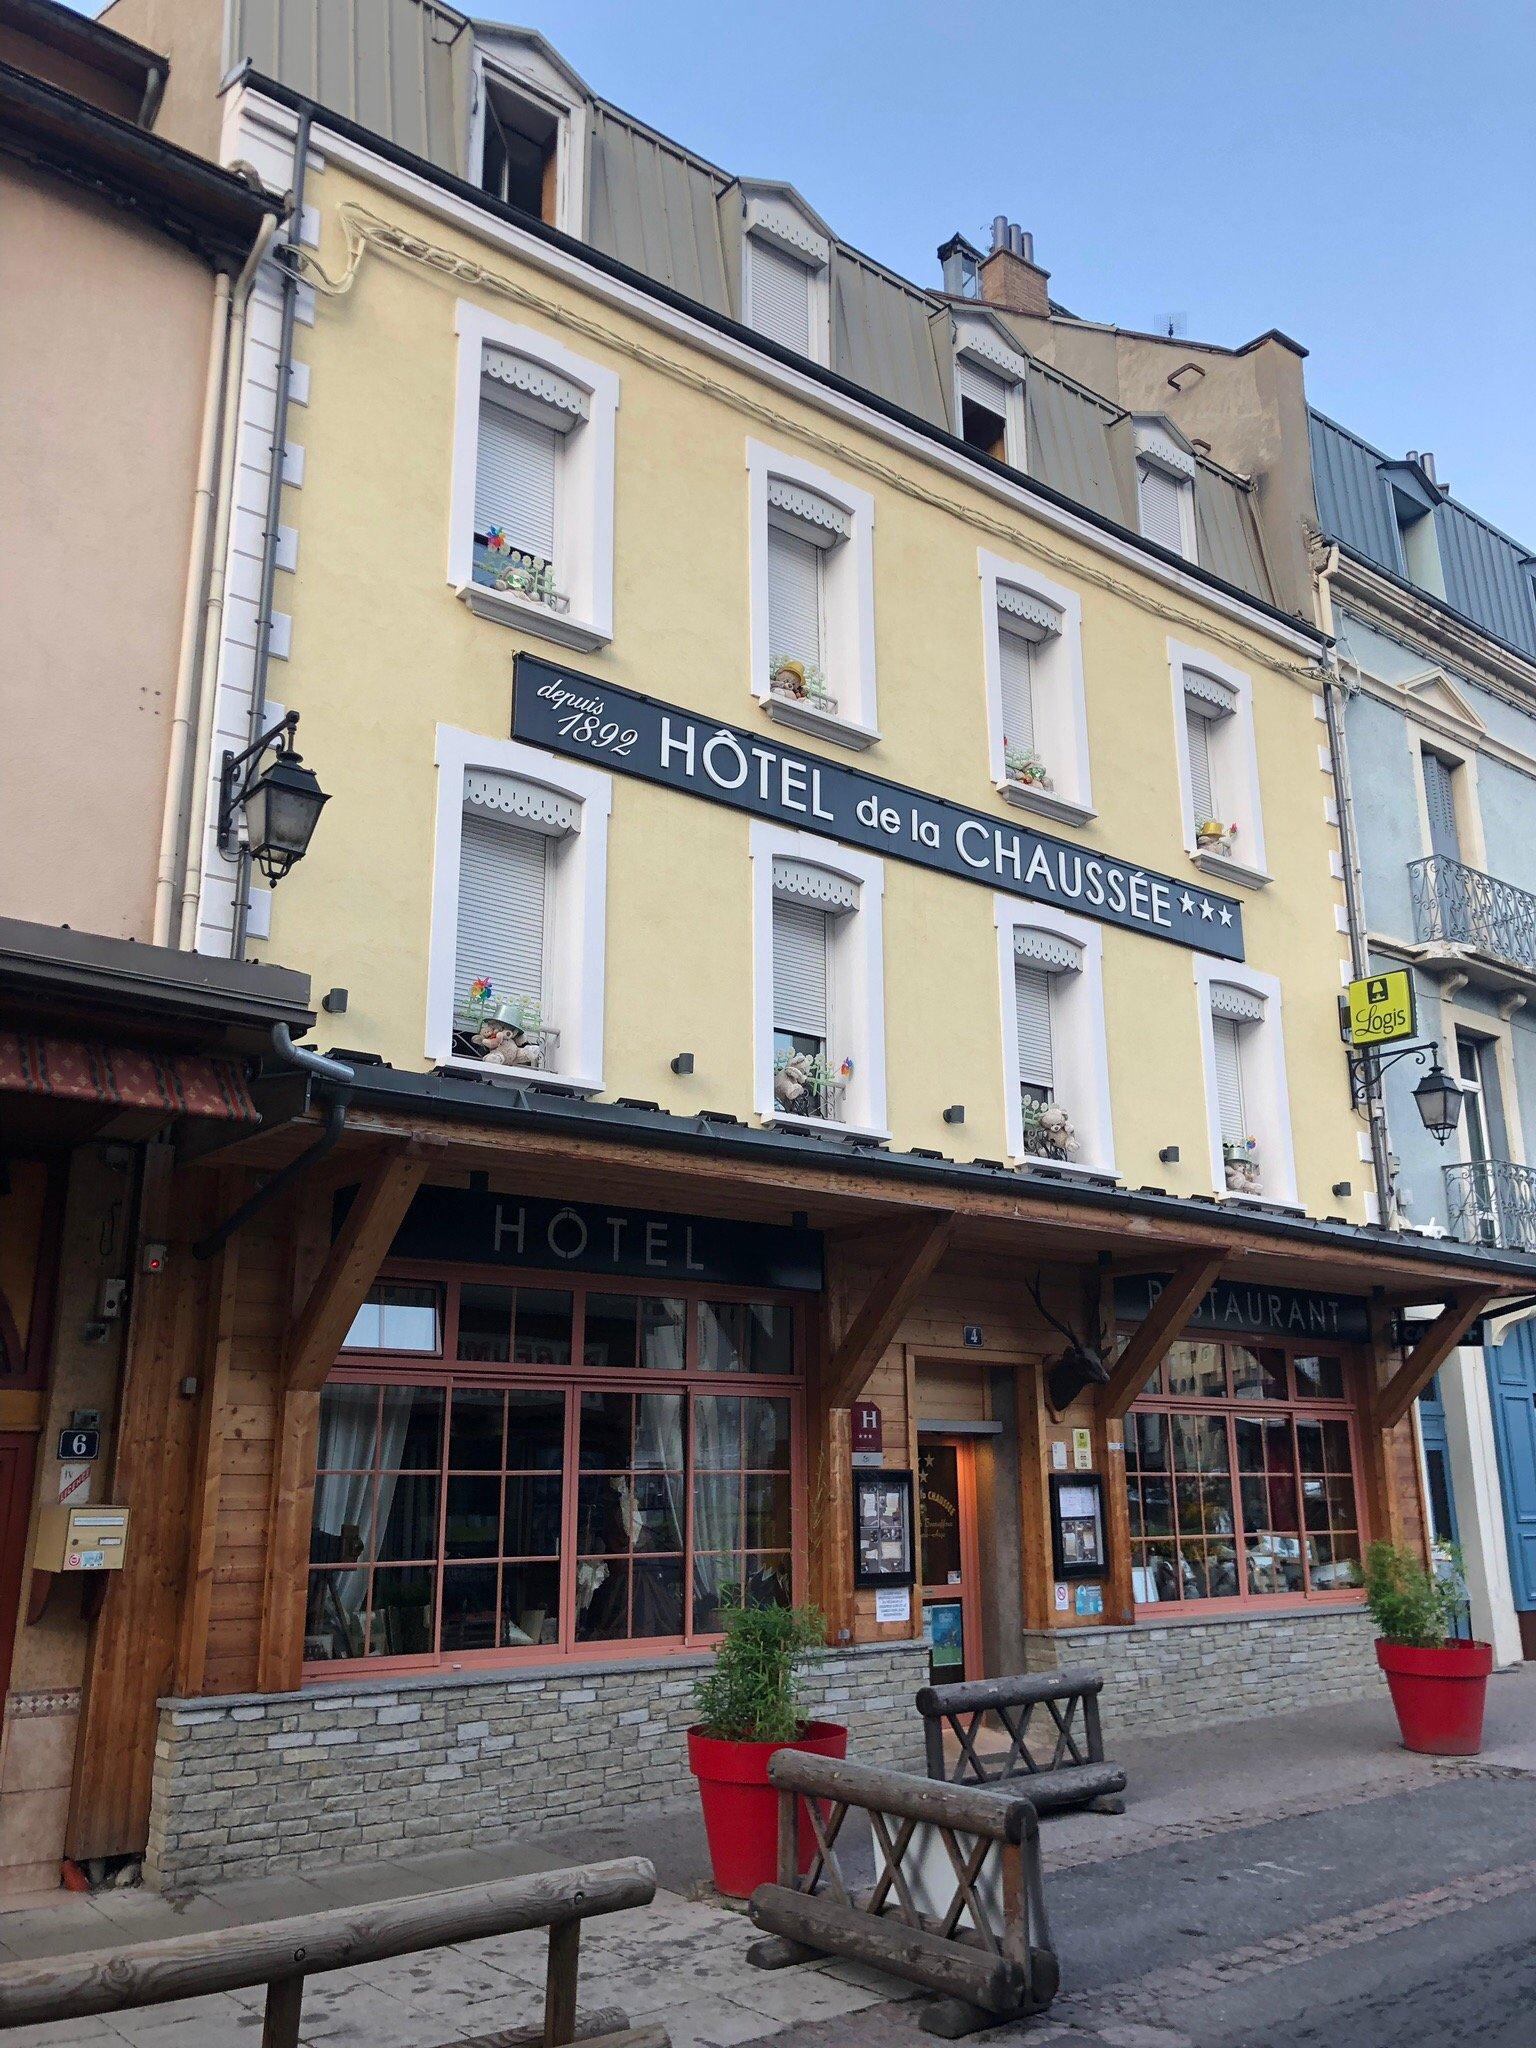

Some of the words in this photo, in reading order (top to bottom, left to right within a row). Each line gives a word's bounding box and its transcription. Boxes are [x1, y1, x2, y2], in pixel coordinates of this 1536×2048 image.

[537, 679, 604, 715] depuis
[558, 713, 638, 756] 1892
[661, 717, 834, 821] HÔTEL
[856, 795, 900, 835] de
[911, 808, 940, 849] la
[955, 820, 1172, 927] CHAUSSÉE
[1355, 1004, 1406, 1036] Logis
[494, 1204, 705, 1271] HÔTEL
[1148, 1279, 1339, 1333] RTAURANT
[970, 1328, 978, 1343] 4
[862, 1410, 877, 1428] H
[72, 1433, 87, 1455] 6
